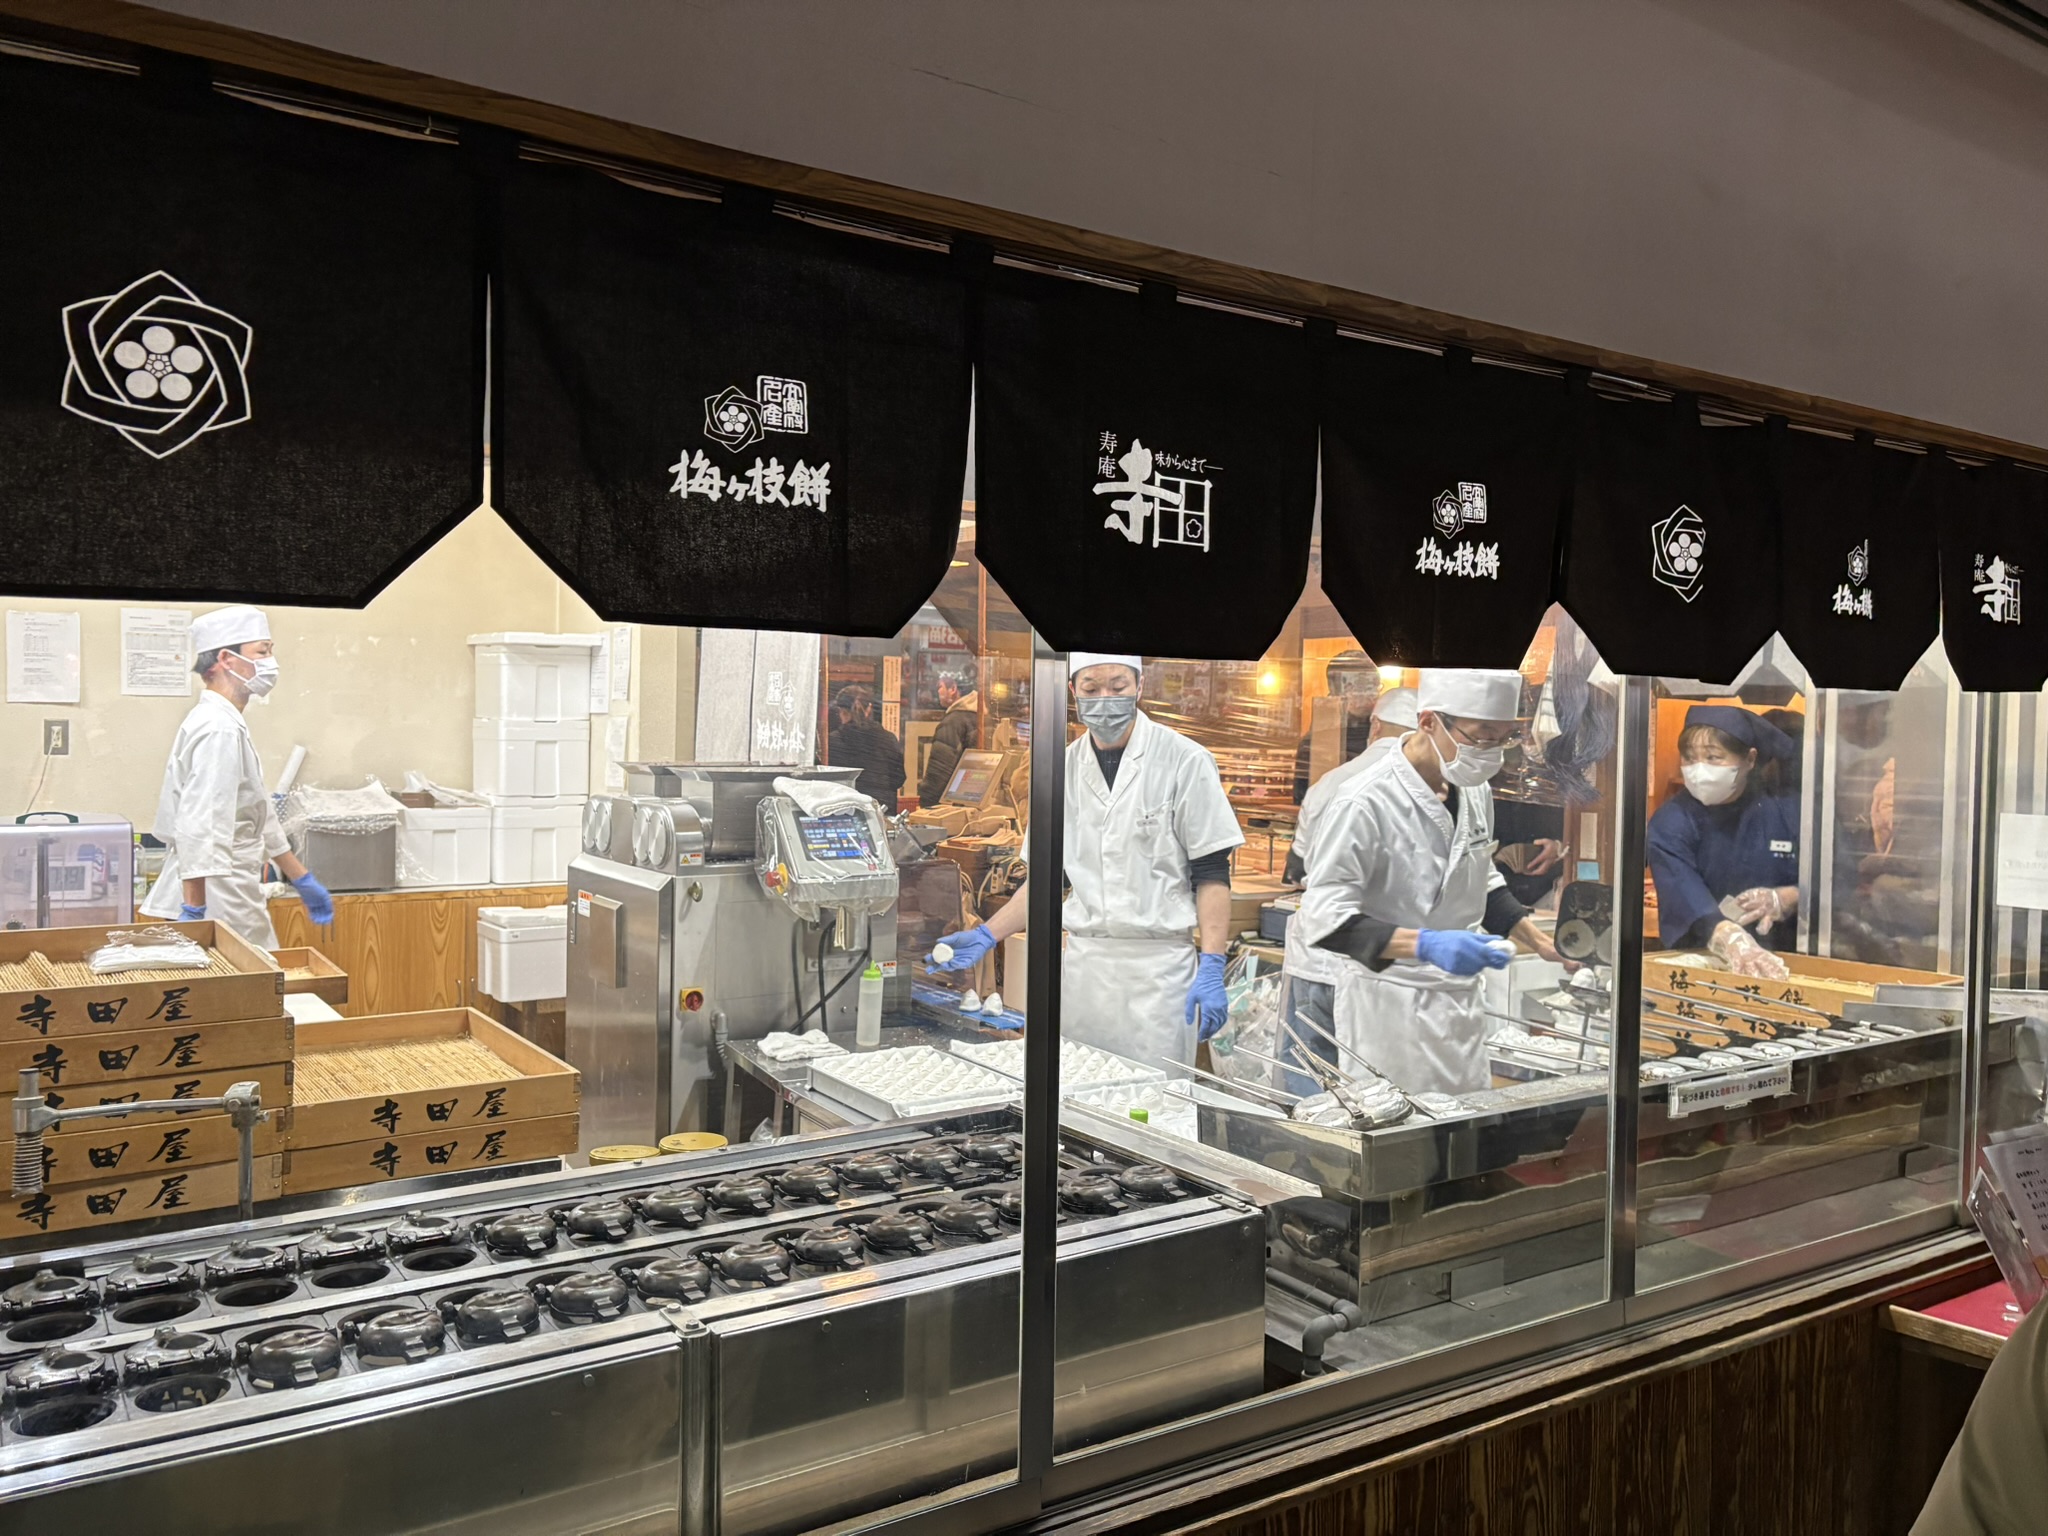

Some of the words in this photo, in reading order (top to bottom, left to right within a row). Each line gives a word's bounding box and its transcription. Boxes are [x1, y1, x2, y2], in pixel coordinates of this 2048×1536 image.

[1097, 430, 1118, 479] 寿庵
[668, 448, 832, 513] 梅ヶ枝餅
[1415, 536, 1500, 580] 梅ヶ枝餅
[16, 986, 193, 1035] 寺田屋
[30, 1033, 203, 1084] 寺田屋
[370, 1087, 509, 1134] 寺田屋
[369, 1129, 508, 1177] 寺田屋
[16, 1173, 191, 1230] 寺田屋
